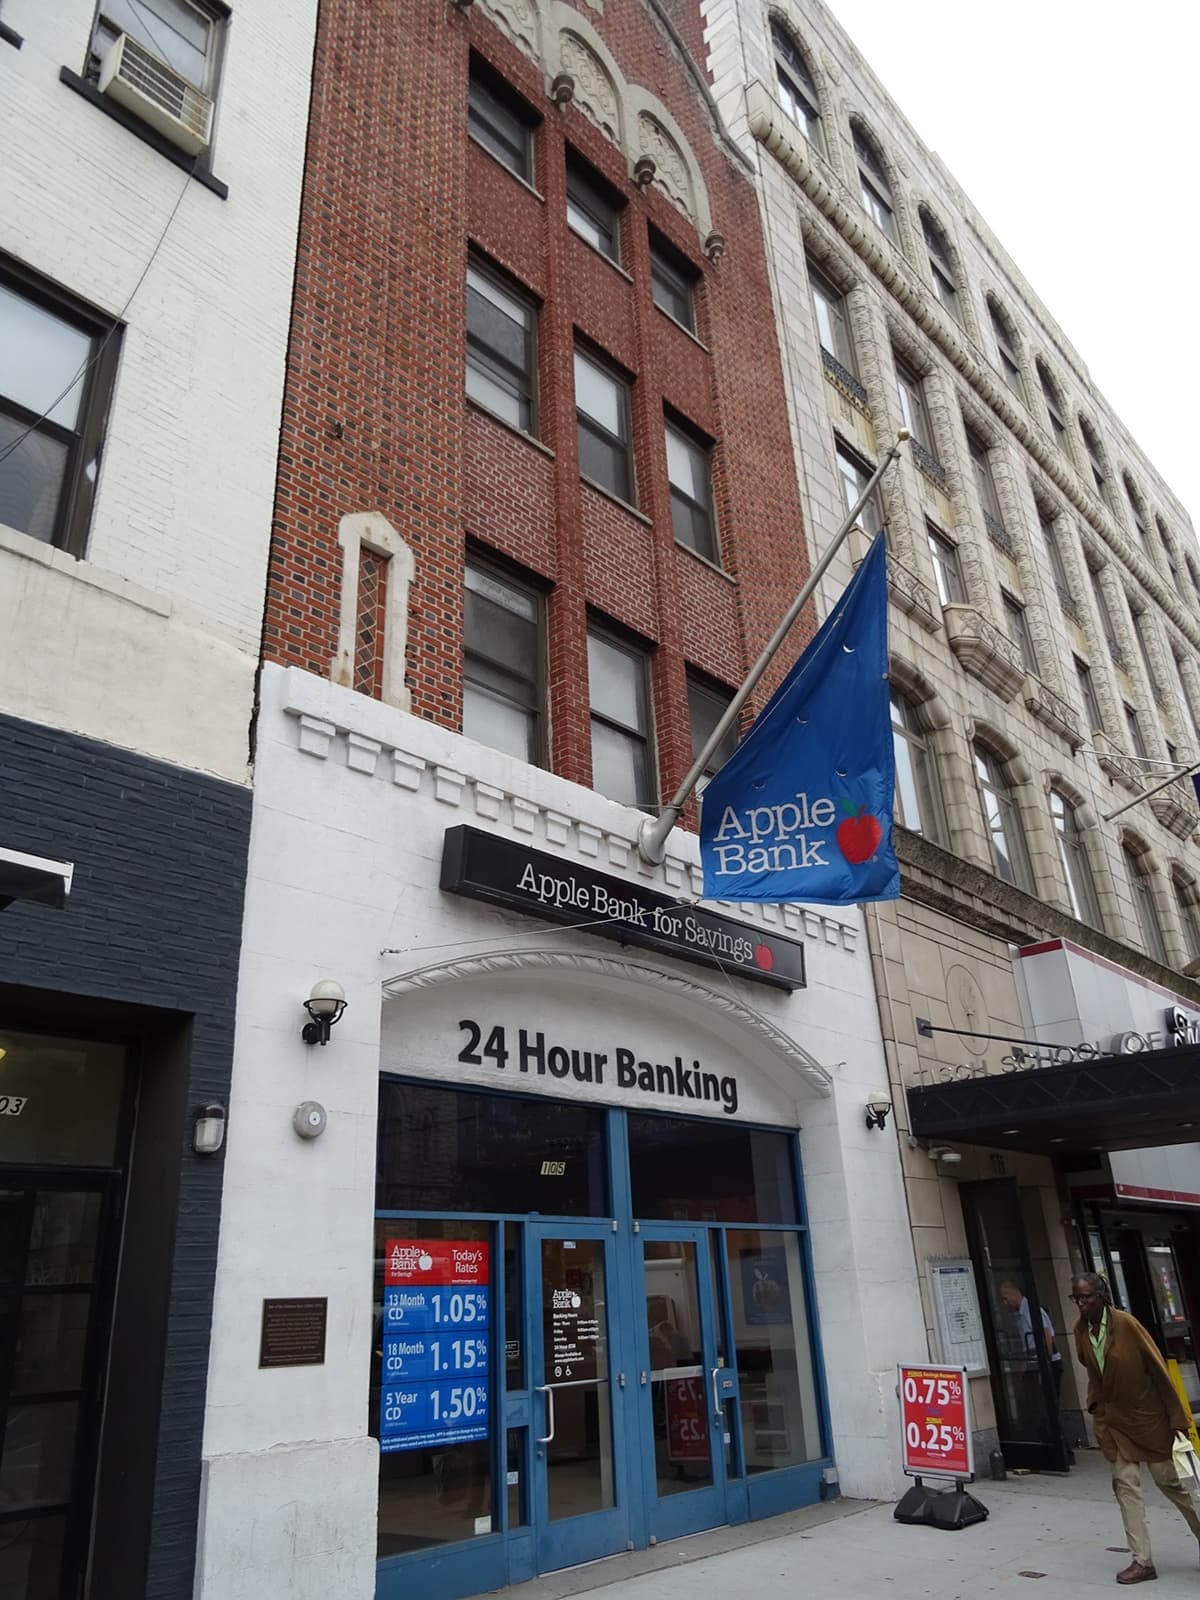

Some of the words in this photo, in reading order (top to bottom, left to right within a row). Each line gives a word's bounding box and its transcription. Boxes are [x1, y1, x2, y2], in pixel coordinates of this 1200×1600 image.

[713, 792, 836, 844] Apple
[713, 834, 830, 876] Bank
[516, 863, 590, 907] Apple
[591, 884, 647, 927] Bank
[652, 907, 682, 937] for
[685, 916, 753, 962] Savings
[1001, 1040, 1115, 1074] SCHOOL
[458, 1019, 508, 1069] 24
[518, 1029, 607, 1084] Hour
[616, 1047, 738, 1114] Banking
[541, 1161, 565, 1175] 105
[391, 1245, 420, 1259] Apple
[452, 1249, 482, 1263] Today's
[390, 1258, 417, 1270] Bank
[456, 1262, 478, 1273] Rates
[389, 1294, 399, 1306] 13
[400, 1293, 425, 1306] Month
[552, 1288, 572, 1300] Apple
[553, 1299, 572, 1309] Bank
[388, 1308, 404, 1320] CD
[388, 1343, 398, 1356] 18
[399, 1341, 425, 1355] Month
[387, 1356, 403, 1370] CD
[386, 1393, 393, 1406] 5
[394, 1391, 418, 1404] Year
[385, 1407, 401, 1420] CD
